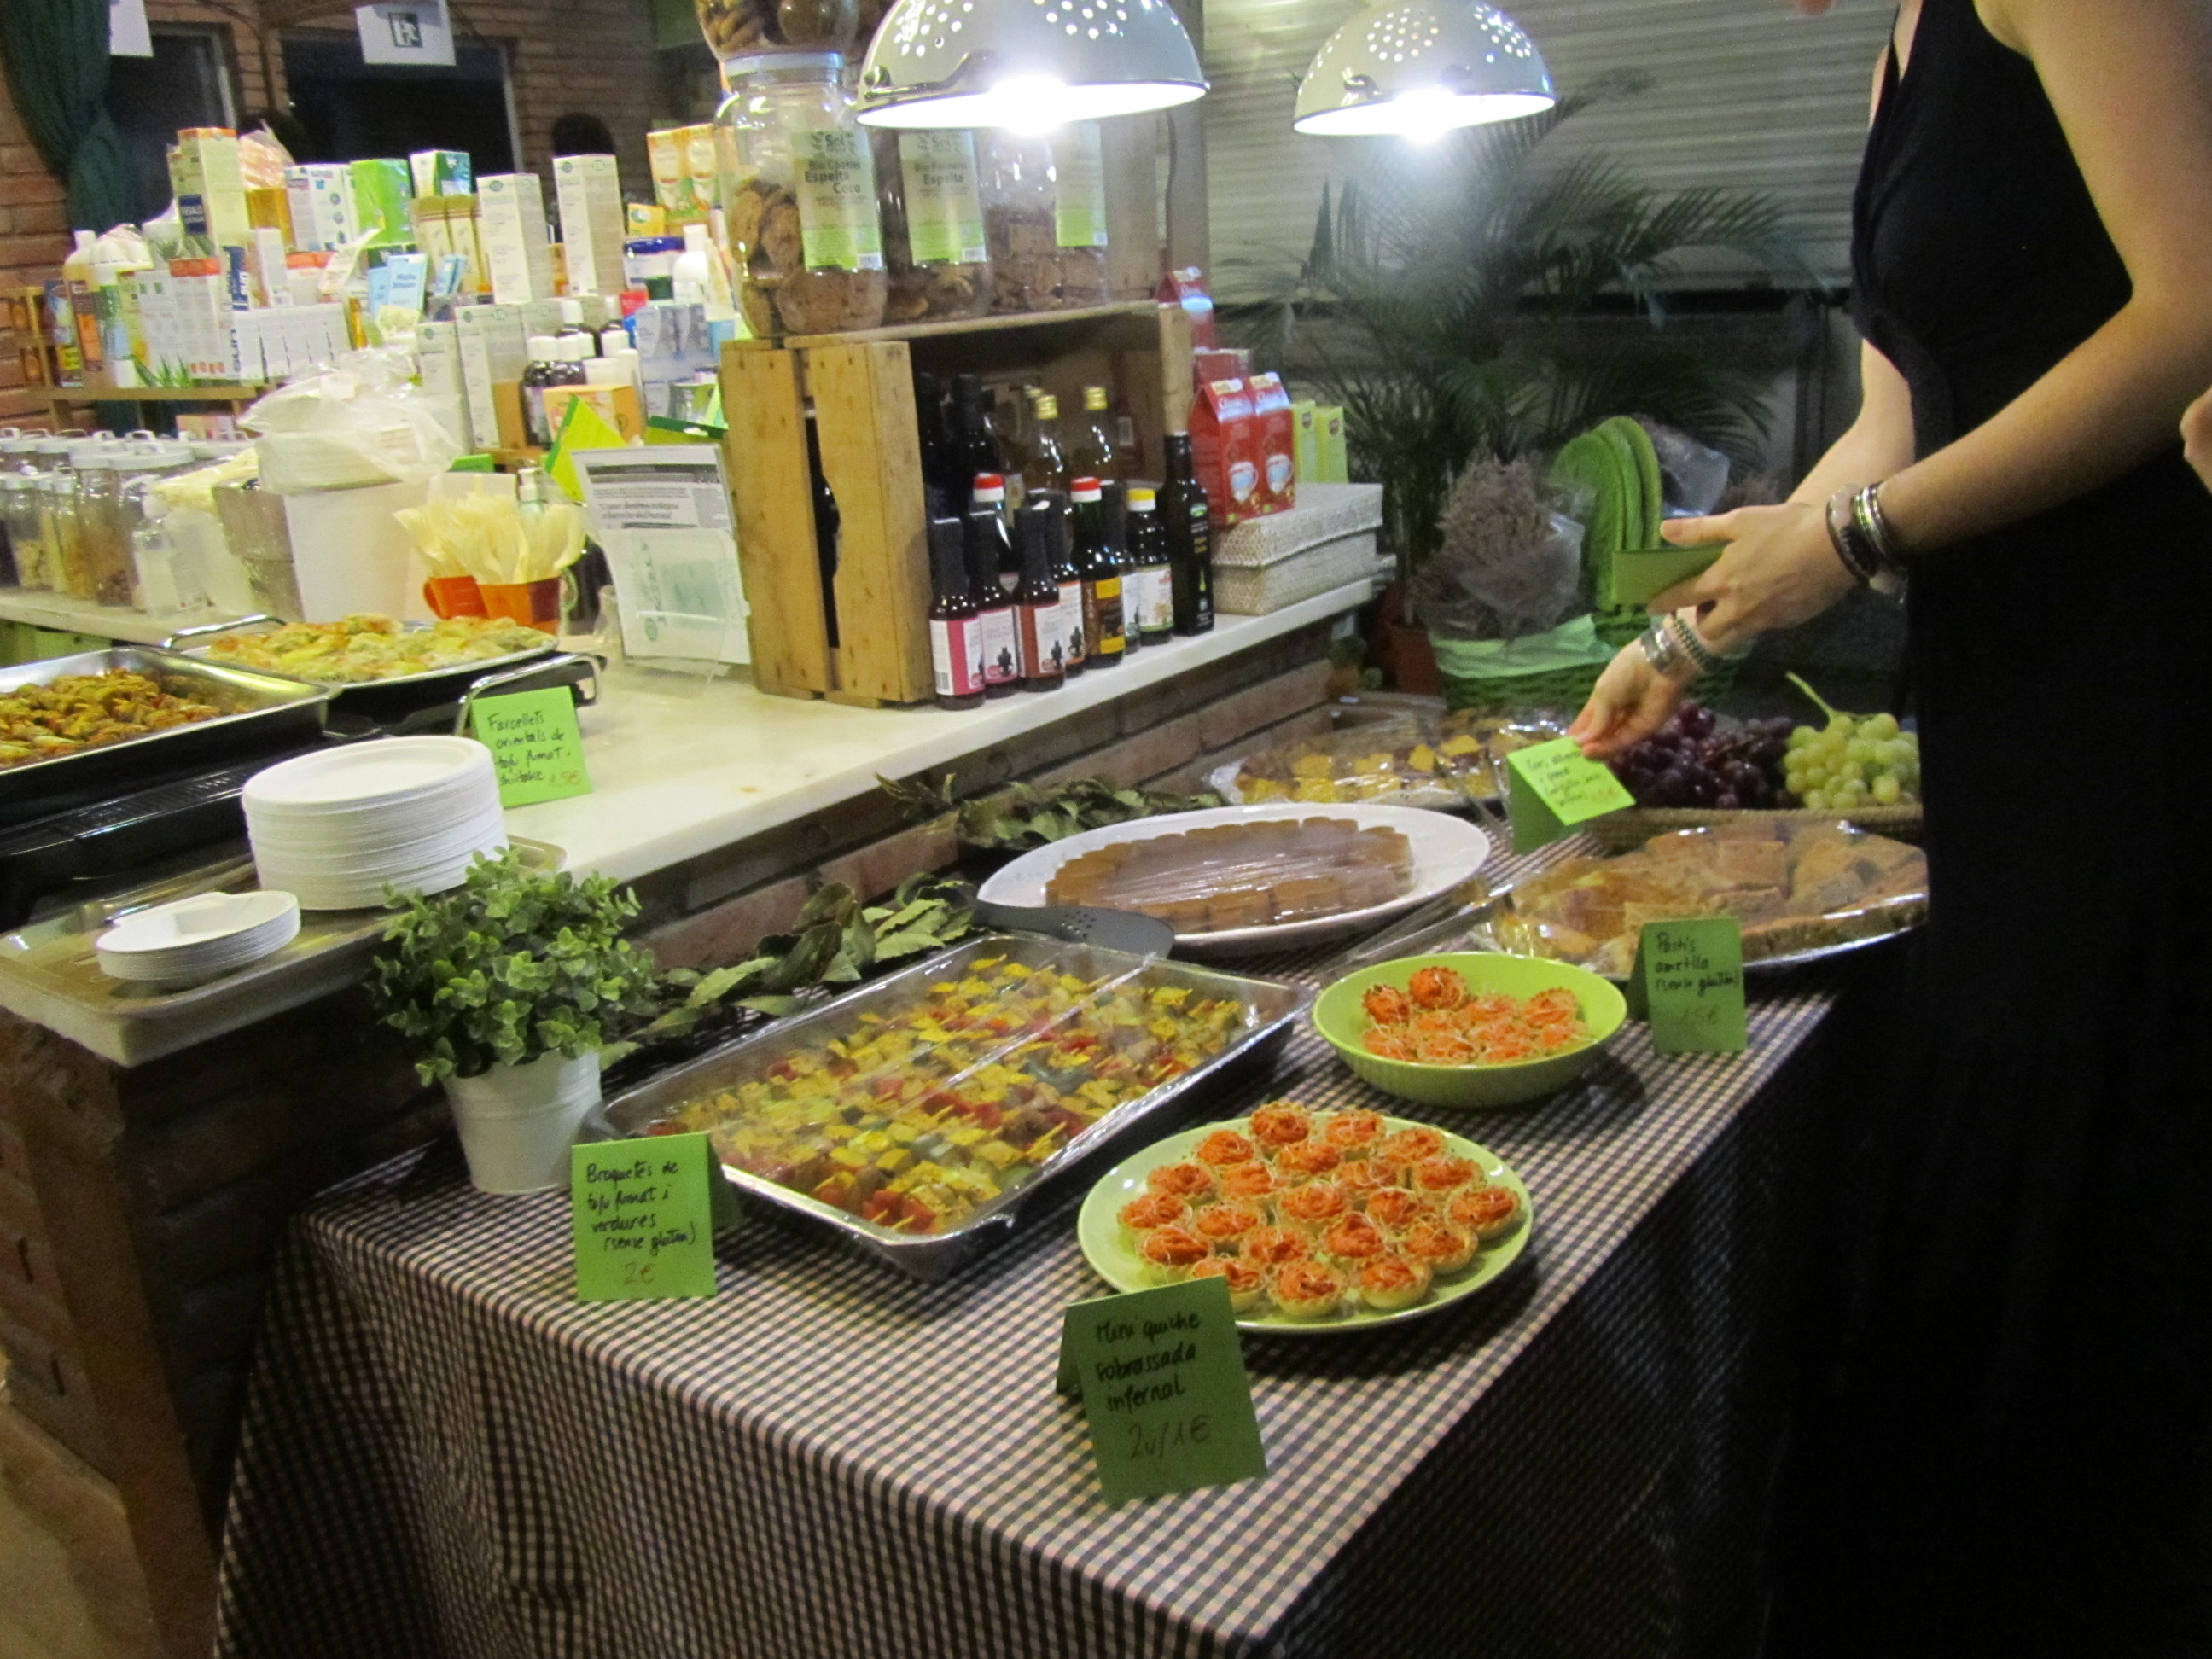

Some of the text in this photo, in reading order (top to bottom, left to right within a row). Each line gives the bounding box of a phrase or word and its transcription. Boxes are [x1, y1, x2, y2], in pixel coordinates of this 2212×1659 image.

[661, 1160, 680, 1174] de
[614, 1186, 657, 1212] fumat
[623, 1260, 656, 1285] 2€
[1107, 1373, 1187, 1414] infernal
